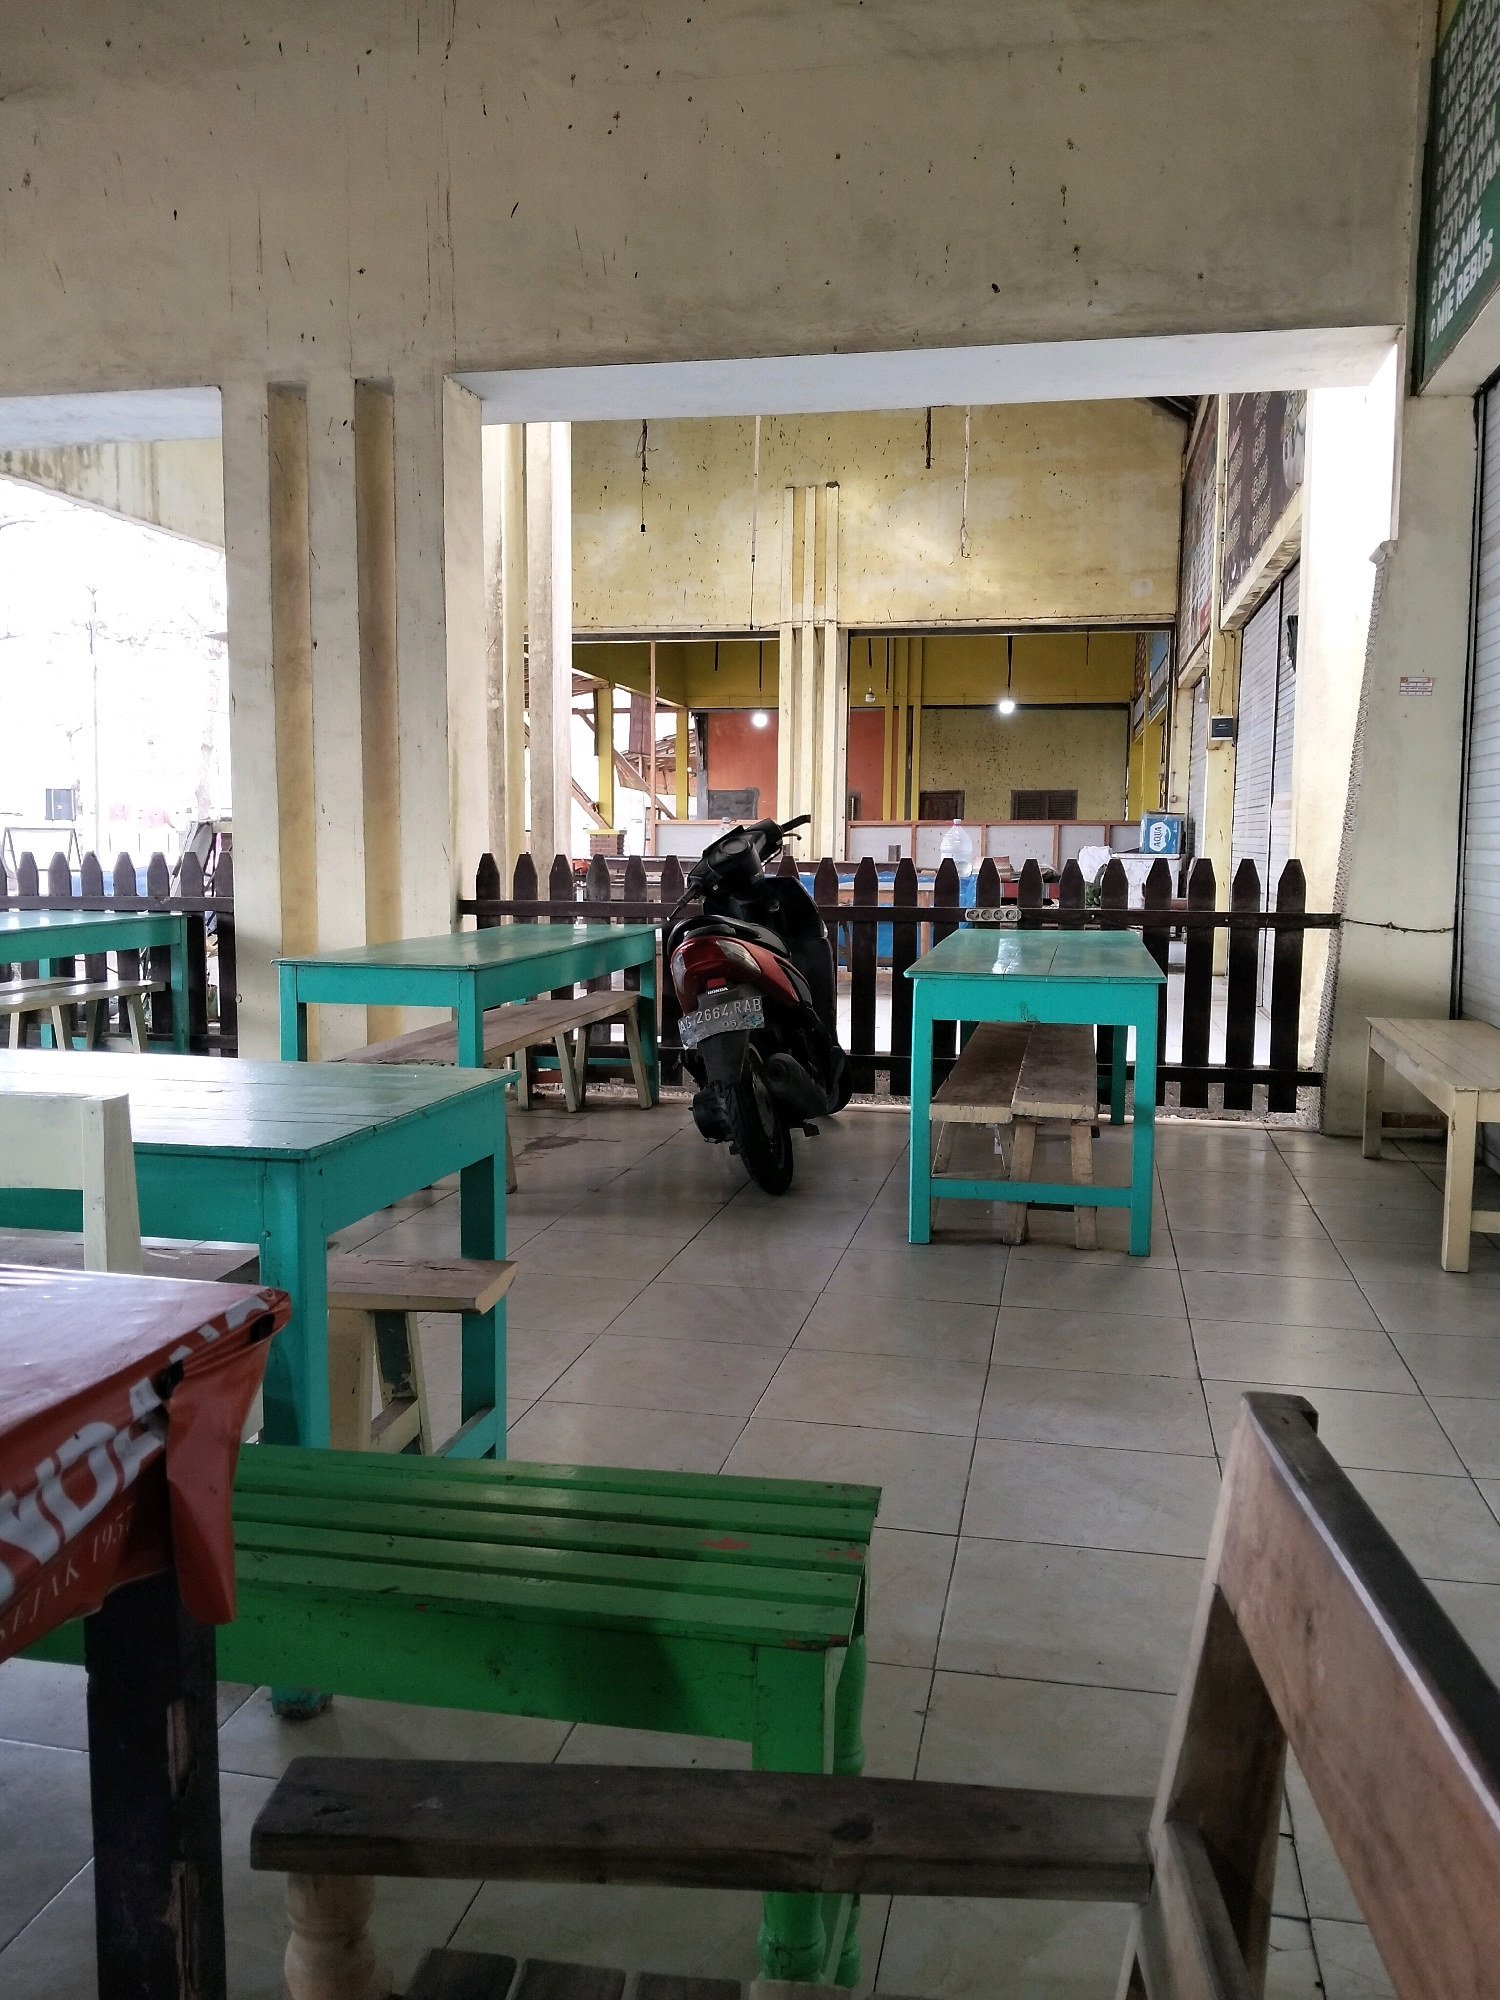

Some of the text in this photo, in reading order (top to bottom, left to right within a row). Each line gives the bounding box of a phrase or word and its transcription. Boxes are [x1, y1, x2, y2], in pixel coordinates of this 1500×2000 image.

[1446, 70, 1471, 146] NASI
[1441, 101, 1497, 223] MIE AYAM
[1444, 112, 1469, 184] NASI
[1438, 205, 1481, 300] POP MIE
[1439, 192, 1468, 262] SOTO
[1436, 228, 1493, 338] MIE REBUS
[1153, 826, 1163, 848] AQUA
[679, 998, 762, 1033] AG 2664 RAB
